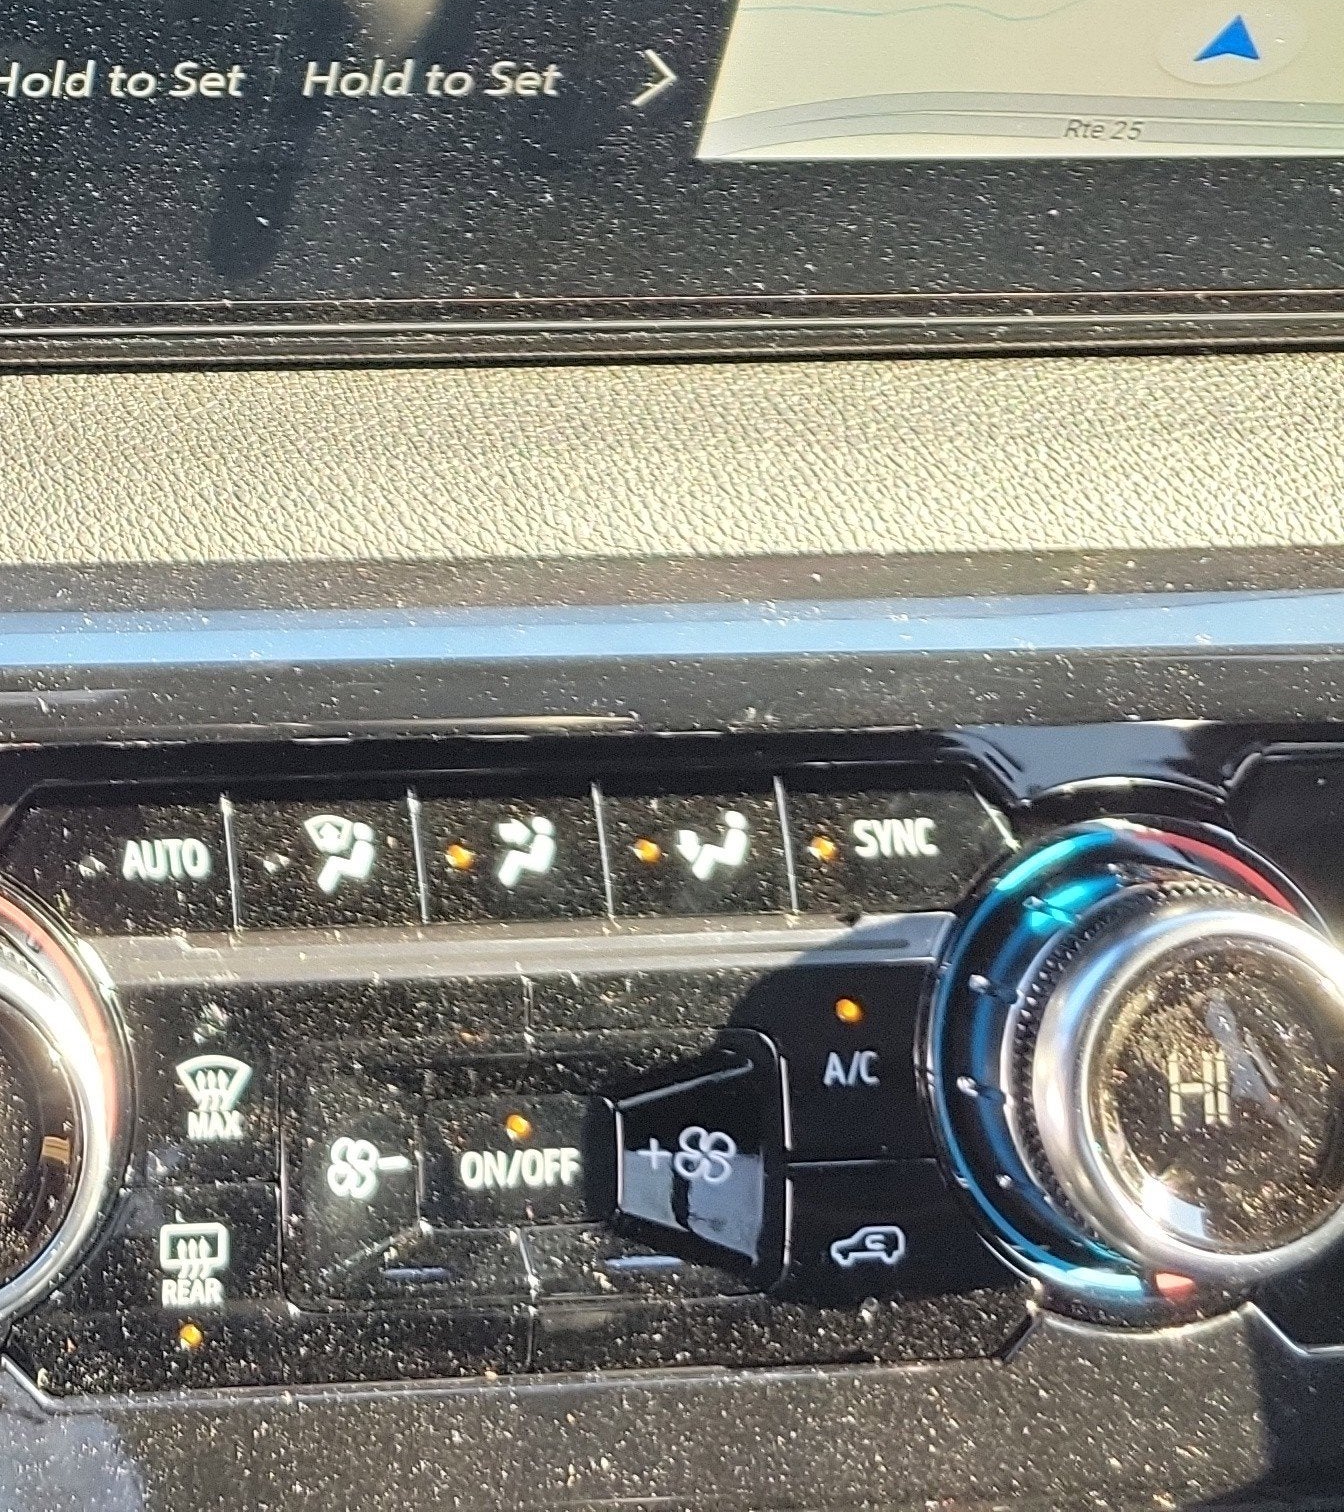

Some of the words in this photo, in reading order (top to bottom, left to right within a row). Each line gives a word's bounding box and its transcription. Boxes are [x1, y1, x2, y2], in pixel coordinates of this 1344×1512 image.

[109, 68, 154, 99] to
[169, 63, 246, 99] Set
[302, 61, 416, 98] Hold
[425, 67, 471, 97] to
[484, 61, 561, 97] Set
[1064, 119, 1104, 139] Rte
[1110, 121, 1145, 140] 25
[854, 819, 938, 857] SYNC
[122, 840, 210, 881] AUTO
[823, 1053, 880, 1086] A/C
[1168, 1050, 1232, 1128] HI
[188, 1112, 242, 1138] MAX
[460, 1148, 580, 1190] ON/OFF
[162, 1278, 222, 1306] REAR
